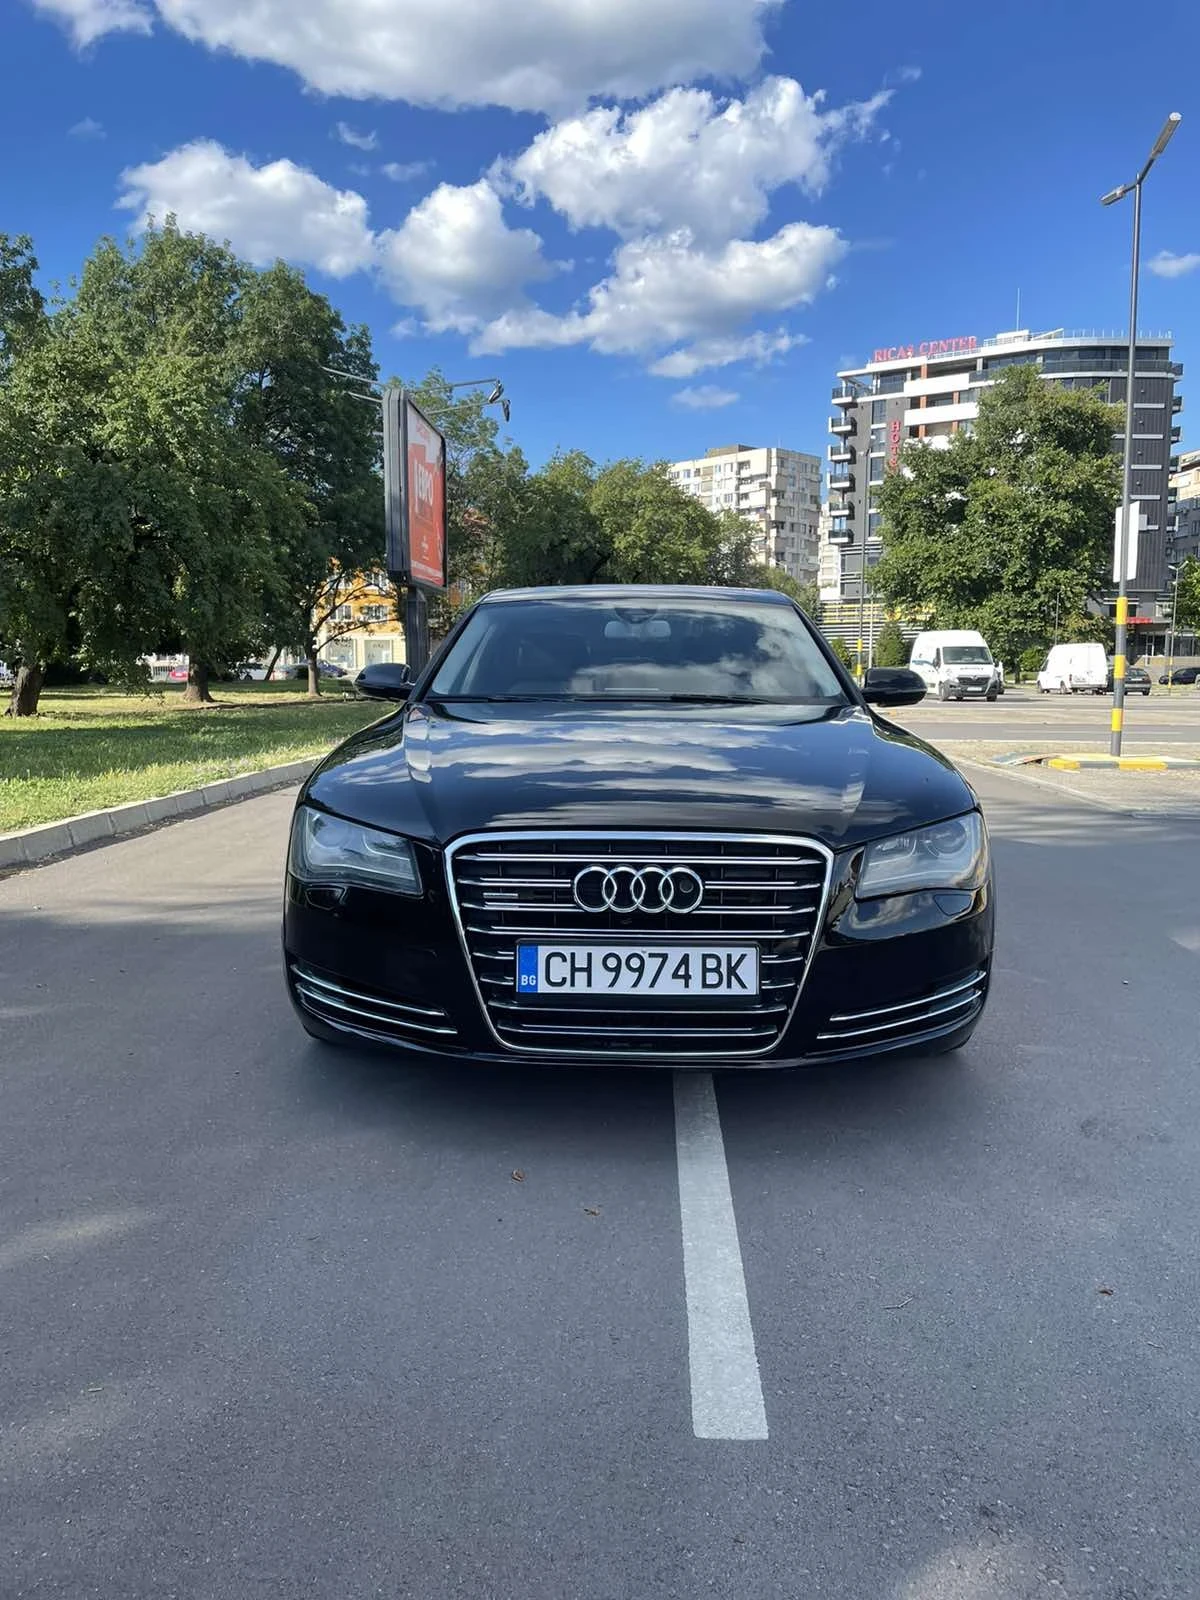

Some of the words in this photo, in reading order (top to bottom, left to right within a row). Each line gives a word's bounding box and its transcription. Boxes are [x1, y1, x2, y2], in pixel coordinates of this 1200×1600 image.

[919, 336, 977, 355] CENTER
[520, 975, 536, 986] BG
[544, 952, 592, 988] CH
[601, 952, 692, 989] 9974
[701, 953, 748, 990] BK
